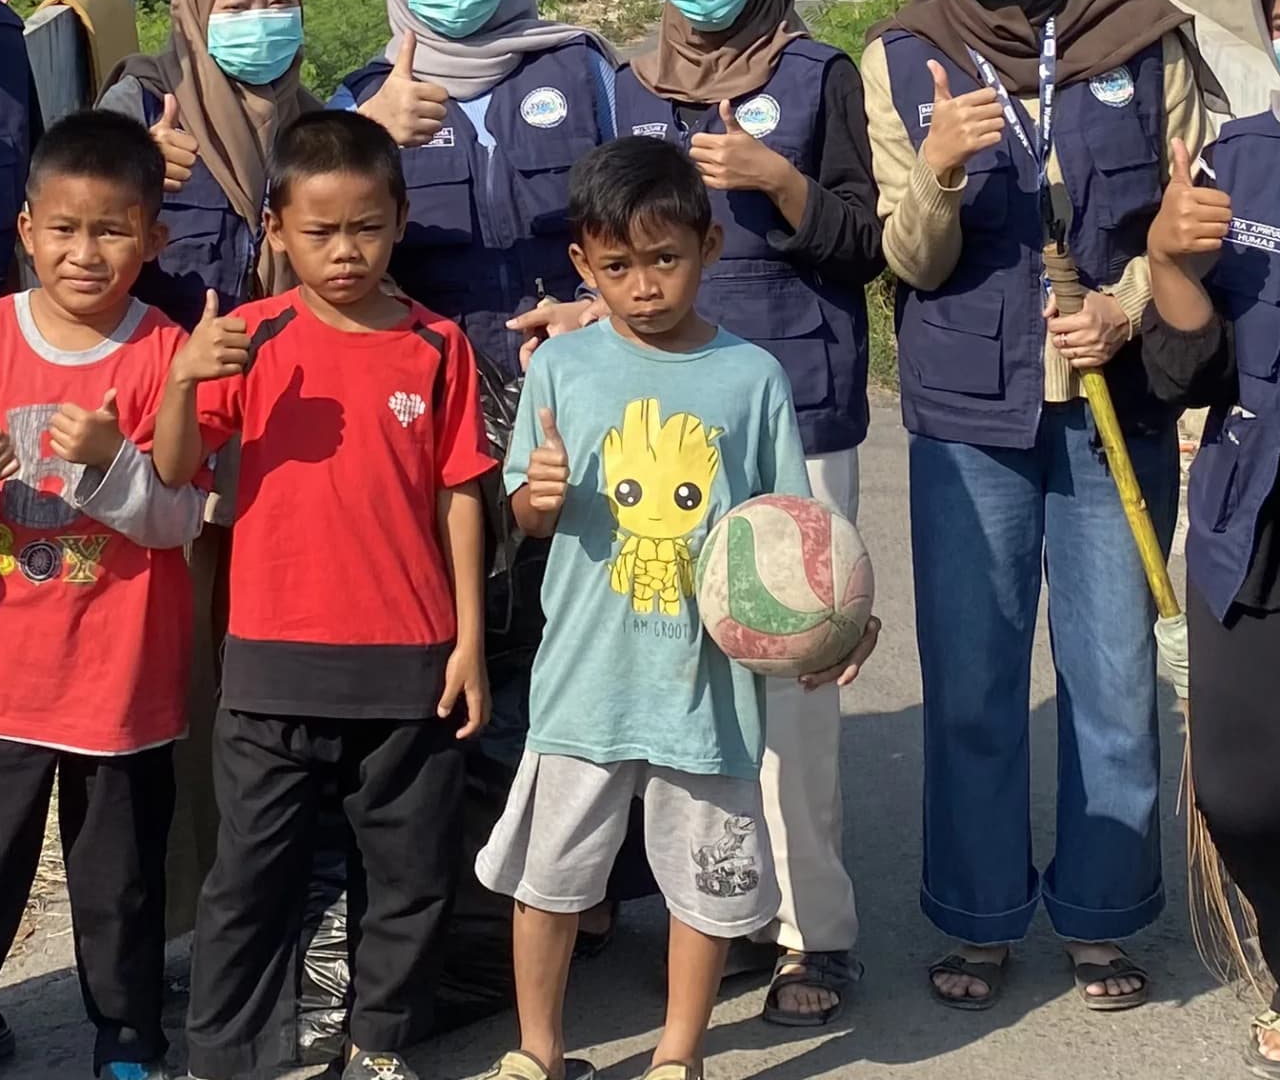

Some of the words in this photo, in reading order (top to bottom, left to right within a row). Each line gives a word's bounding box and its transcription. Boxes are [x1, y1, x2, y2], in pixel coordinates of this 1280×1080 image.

[1237, 233, 1275, 249] HUMAS
[633, 618, 649, 634] AM
[654, 619, 689, 640] GROOT
